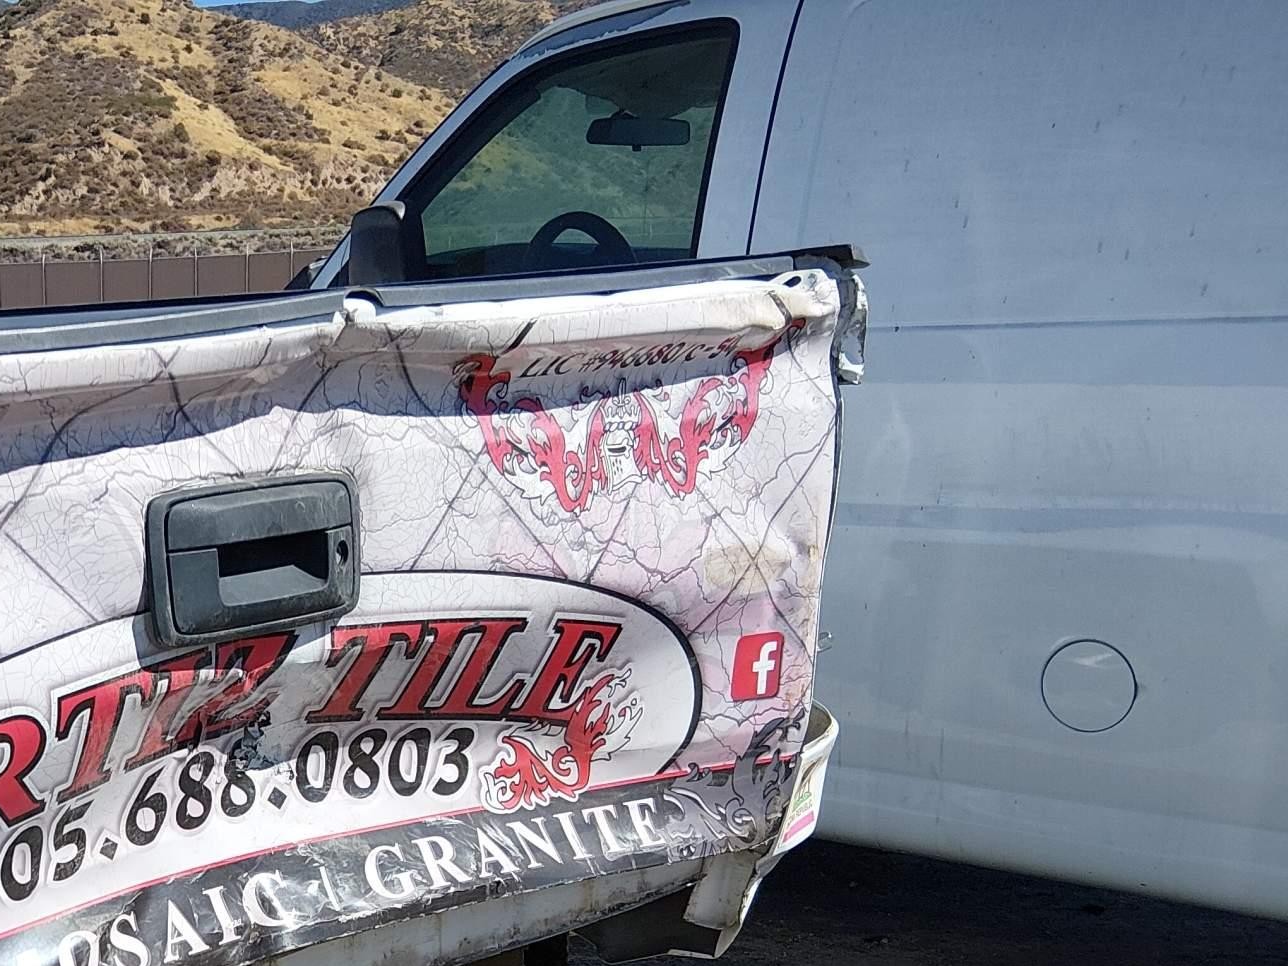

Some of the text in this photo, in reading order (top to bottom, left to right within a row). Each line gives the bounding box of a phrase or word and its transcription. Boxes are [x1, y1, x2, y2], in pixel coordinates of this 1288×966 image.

[519, 352, 586, 378] LIC
[306, 619, 621, 724] TILE
[364, 797, 667, 899] GRANITE
